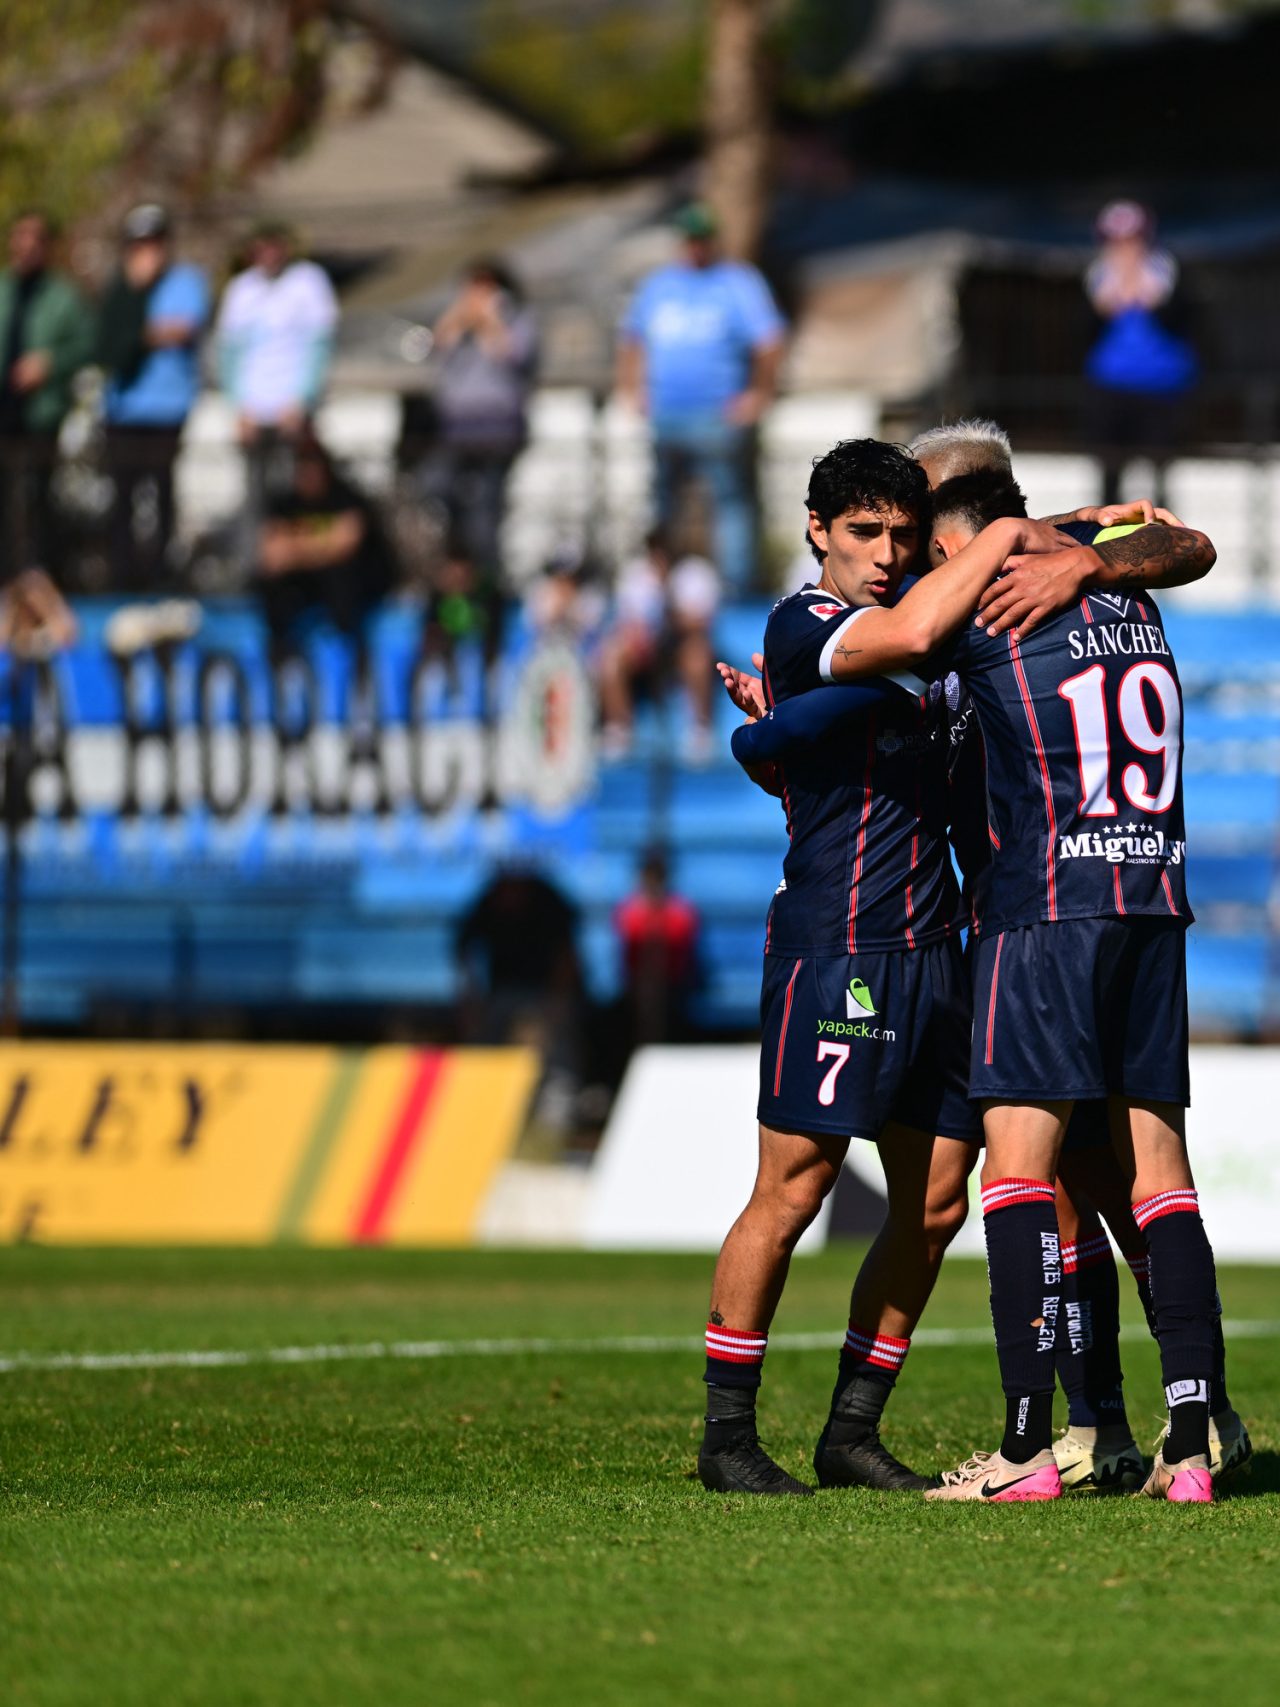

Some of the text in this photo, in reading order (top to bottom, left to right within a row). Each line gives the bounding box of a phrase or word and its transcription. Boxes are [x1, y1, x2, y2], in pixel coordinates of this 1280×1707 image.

[1057, 660, 1181, 818] 19
[817, 1020, 896, 1042] yapack.cm
[816, 1040, 850, 1107] 7
[1040, 1231, 1061, 1285] DEPORTES
